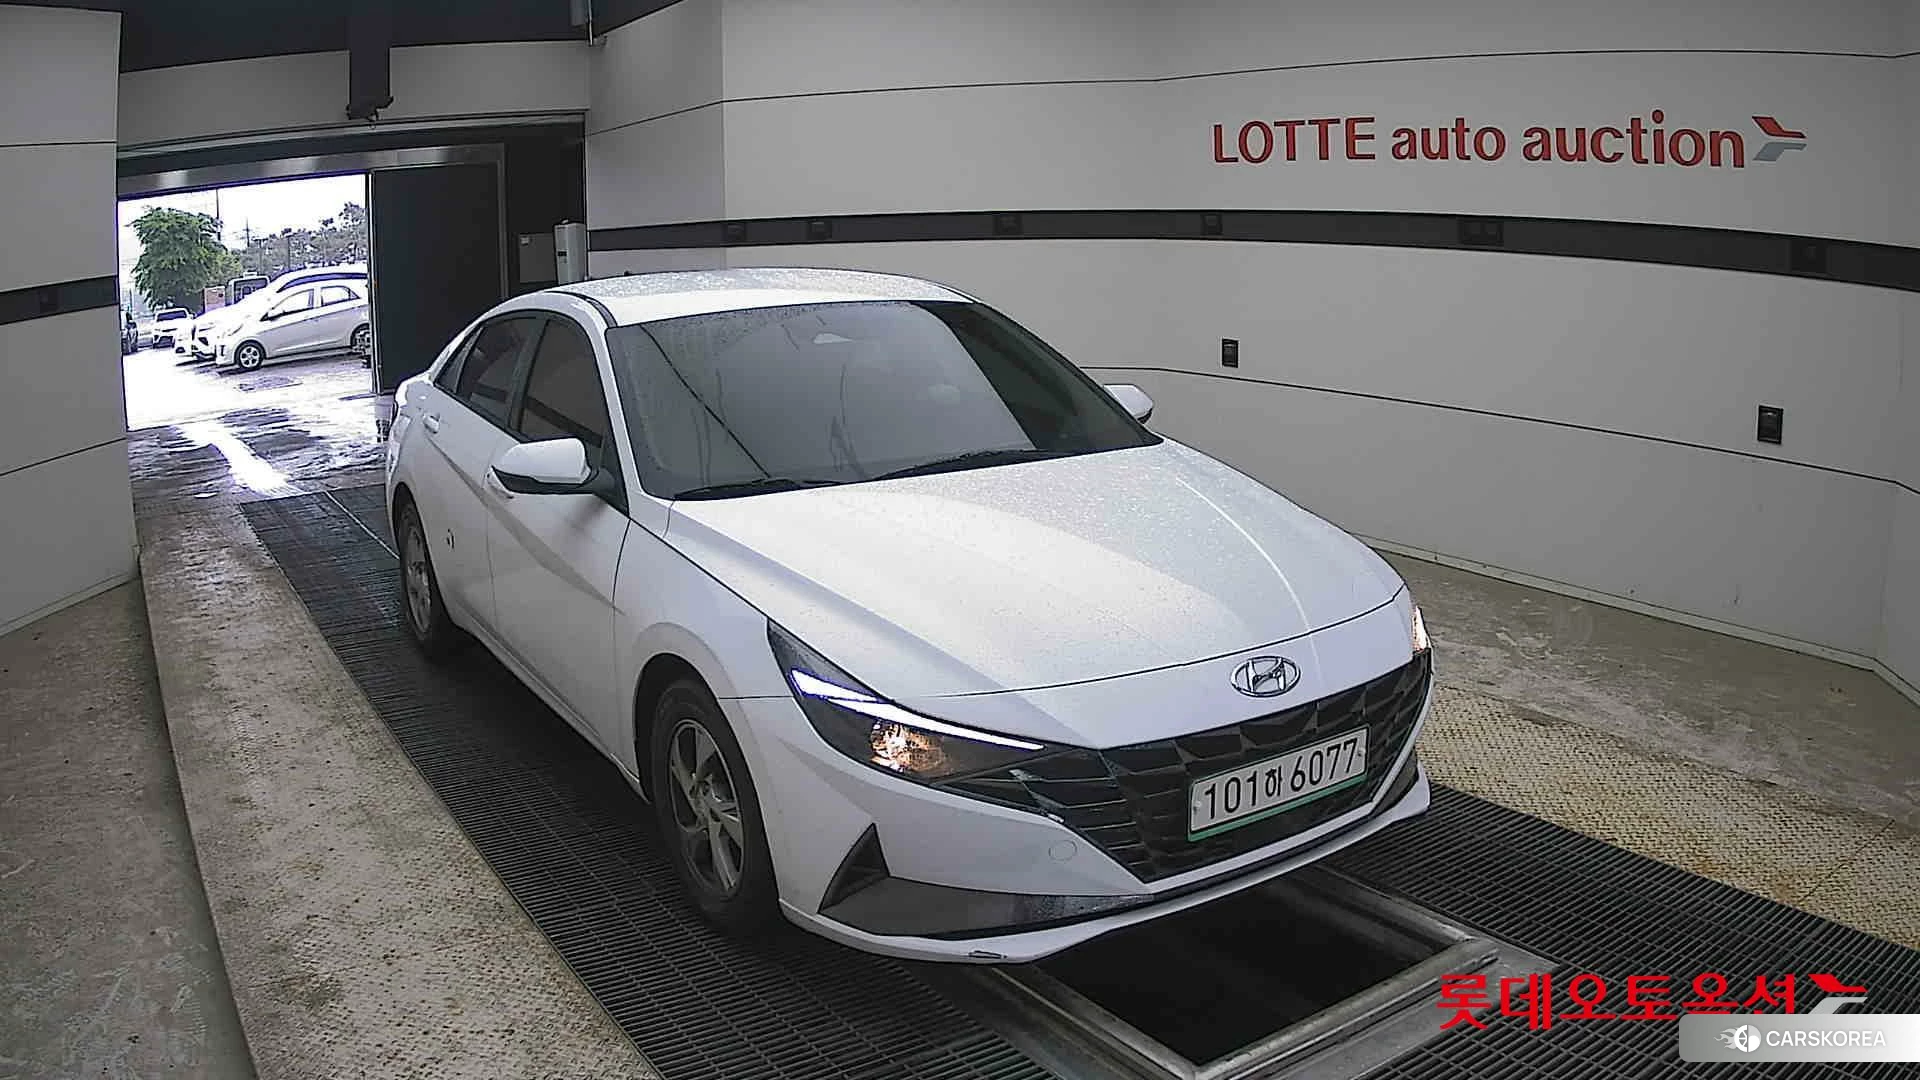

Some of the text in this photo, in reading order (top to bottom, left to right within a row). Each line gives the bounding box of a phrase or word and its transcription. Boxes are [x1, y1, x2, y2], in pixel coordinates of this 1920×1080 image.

[1213, 109, 1745, 168] LOTTE auto auction
